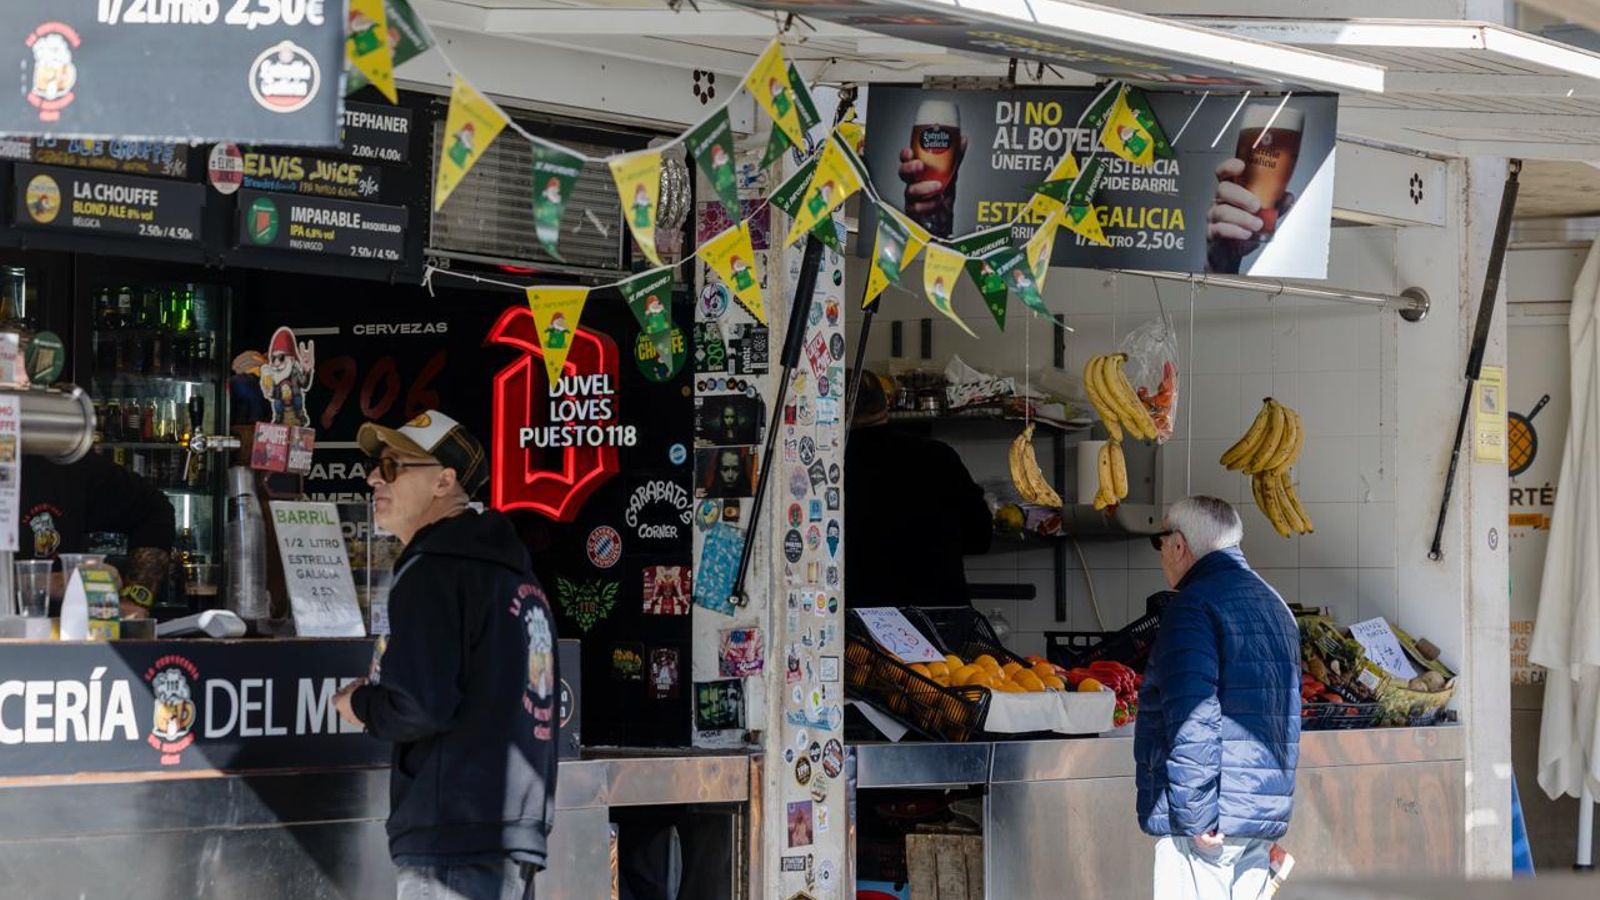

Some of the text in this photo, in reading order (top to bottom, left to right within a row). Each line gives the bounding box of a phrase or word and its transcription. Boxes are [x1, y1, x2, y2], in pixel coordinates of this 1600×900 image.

[995, 101, 1063, 125] DI NO
[992, 126, 1023, 150] AL
[991, 152, 1055, 172] ÚNETE A
[73, 181, 158, 206] LA CHOUFFE
[1099, 176, 1178, 194] PIDE BARRIL
[73, 201, 106, 216] BLOND
[109, 205, 126, 218] ALE
[290, 206, 402, 233] IMPARABLE BASQUELAND
[1098, 206, 1187, 231] GALICIA
[290, 224, 303, 236] IPA
[1136, 230, 1186, 252] 2,50€
[352, 322, 449, 336] CERVEZAS
[549, 374, 614, 398] DUVEL
[550, 398, 612, 423] LOVES
[519, 425, 637, 449] PUESTO 118
[304, 463, 367, 481] ARA
[275, 508, 335, 526] BARRIL
[637, 524, 678, 539] CORNER
[285, 538, 340, 549] 1/2 LITRO
[289, 554, 344, 566] ESTRELLA
[0, 667, 138, 743] CERÍA
[204, 678, 287, 737] DEL
